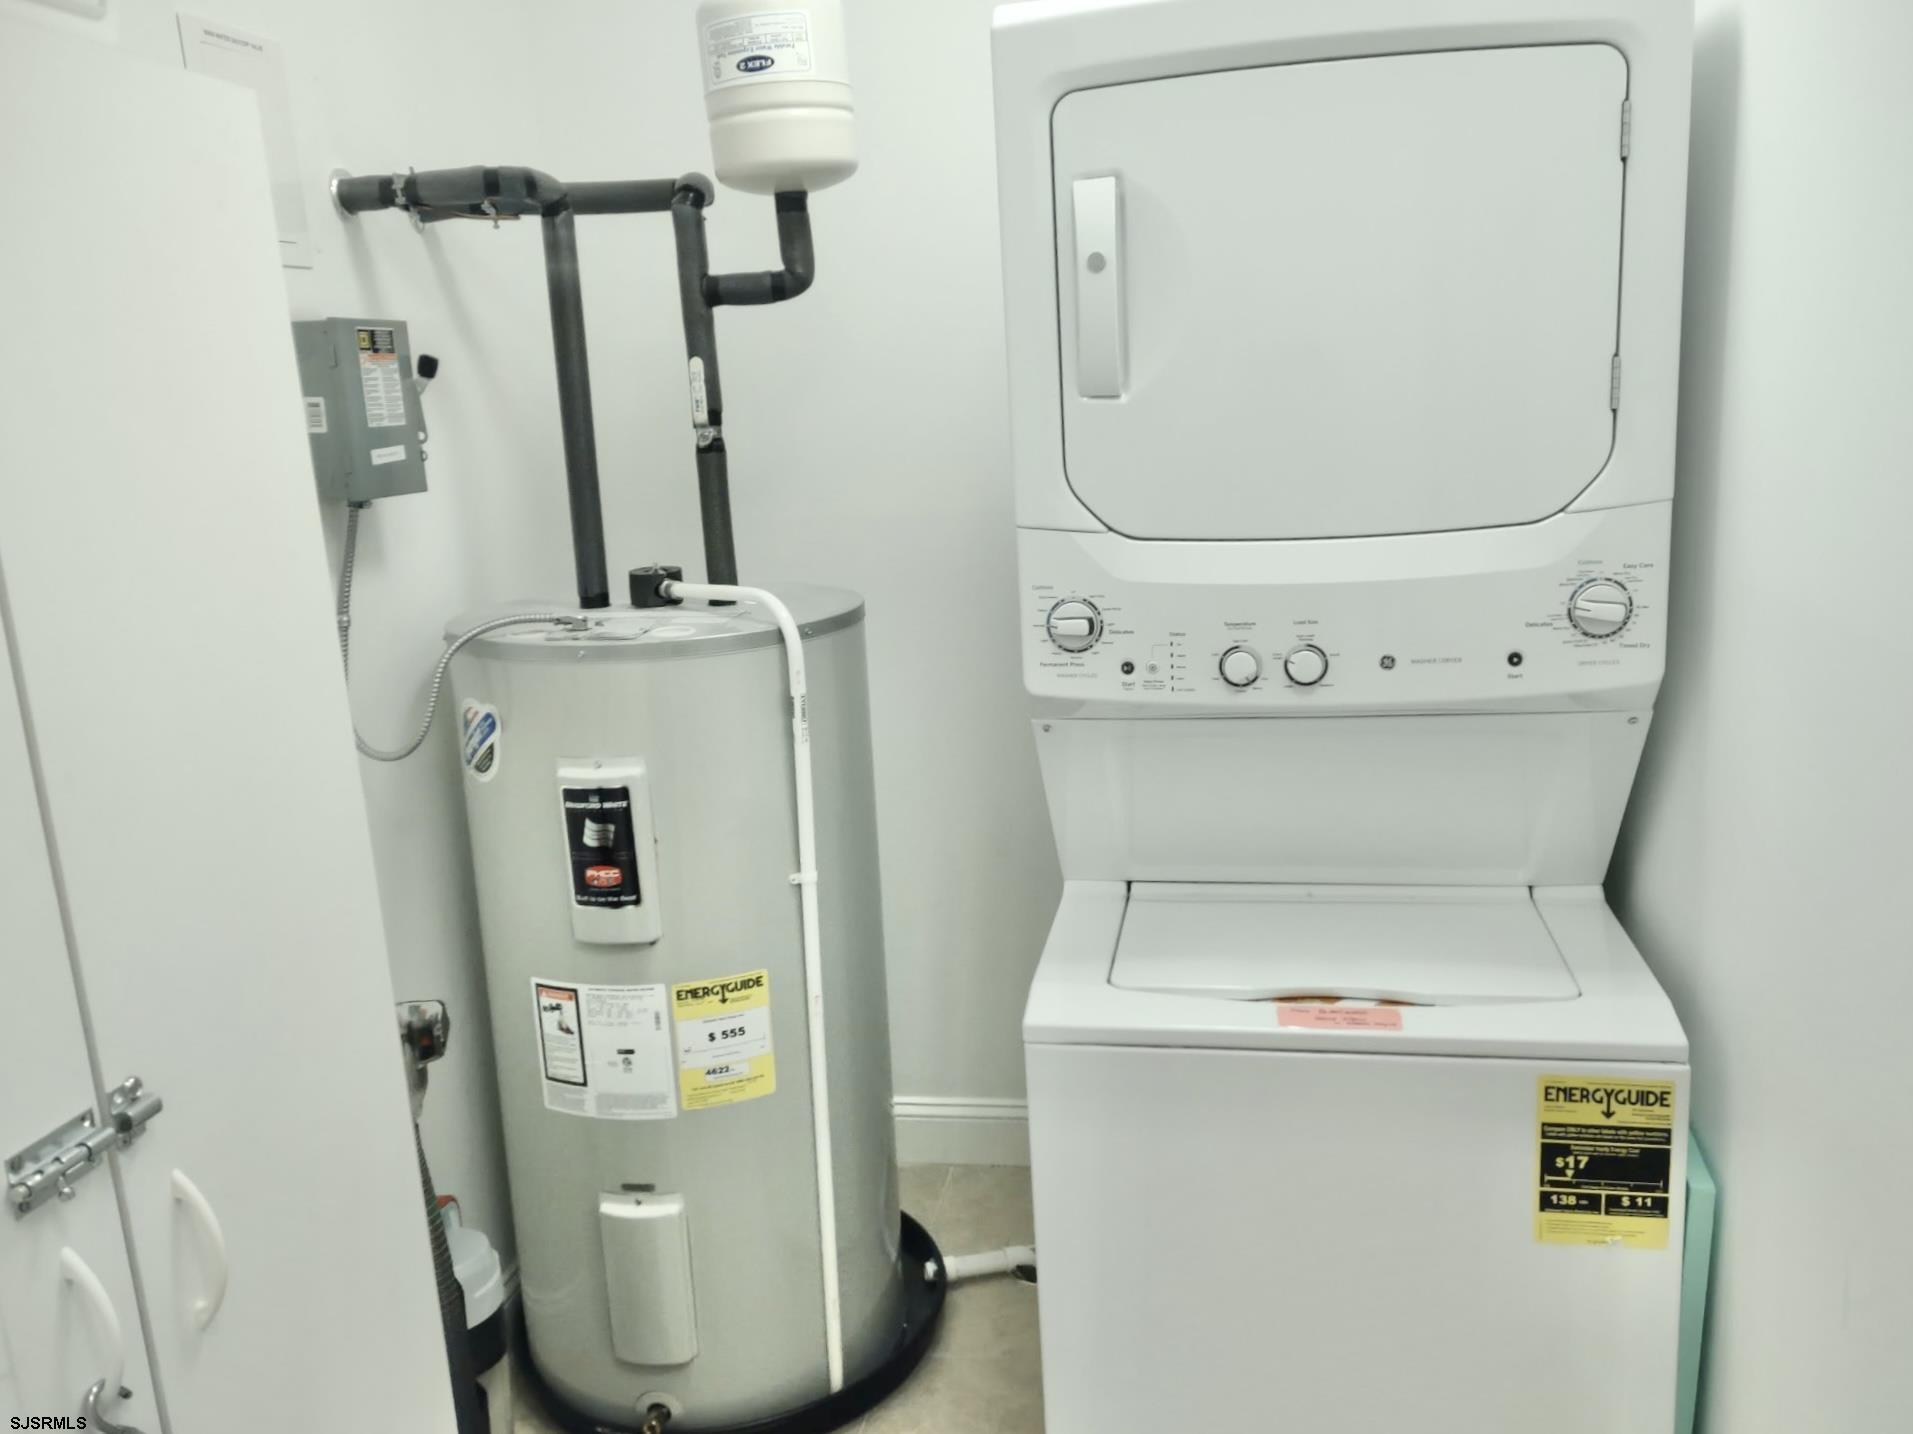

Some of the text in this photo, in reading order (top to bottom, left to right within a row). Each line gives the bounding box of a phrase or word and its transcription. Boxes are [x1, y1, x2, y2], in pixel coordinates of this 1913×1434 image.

[739, 58, 773, 70] FLEX 2
[676, 976, 764, 1001] ENERGYGUIDE
[708, 1026, 746, 1042] $ 555
[1544, 1085, 1671, 1108] ENERGYGUIDE
[1555, 1155, 1590, 1169] $17
[1550, 1194, 1577, 1206] 138
[1621, 1196, 1652, 1207] $ 11
